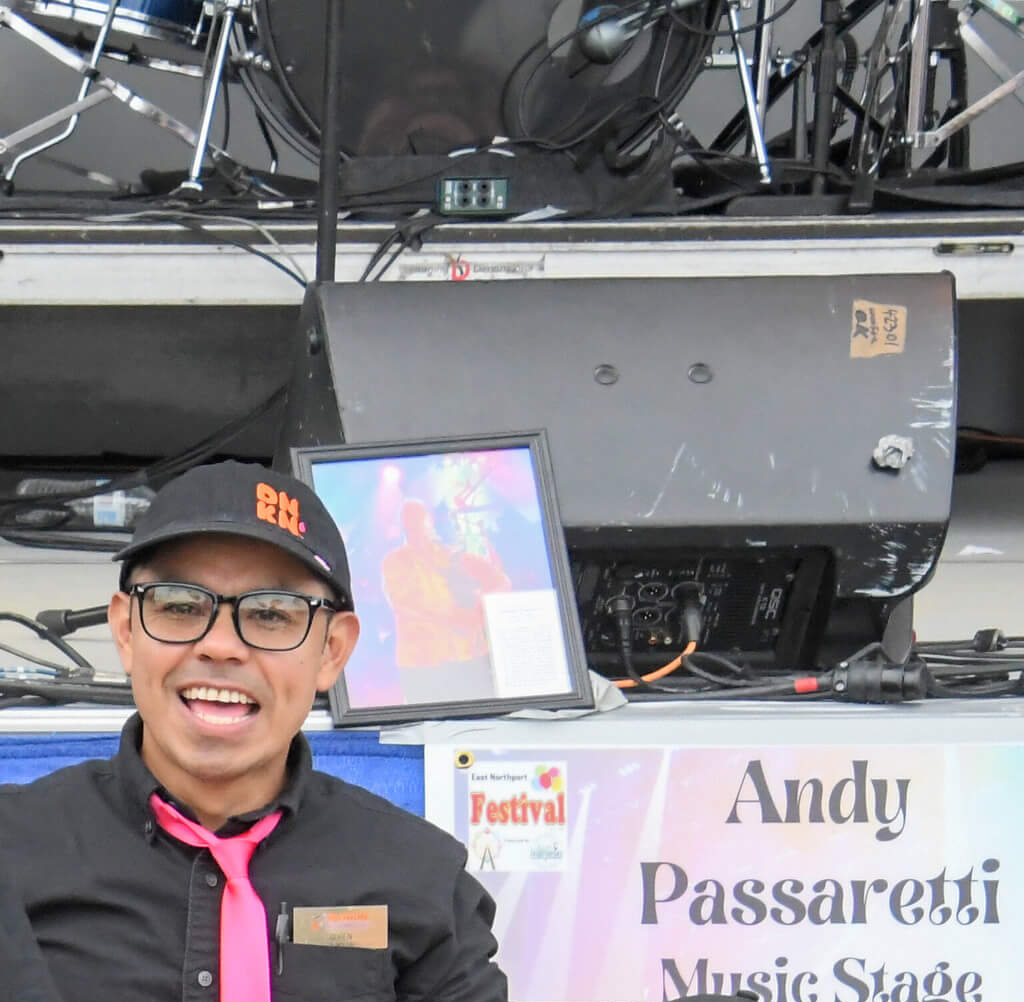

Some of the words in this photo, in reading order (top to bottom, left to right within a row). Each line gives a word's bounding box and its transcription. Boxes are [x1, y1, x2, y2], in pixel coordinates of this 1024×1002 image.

[470, 792, 566, 825] Festival
[725, 760, 911, 841] Andy
[640, 858, 1000, 926] Passaretti
